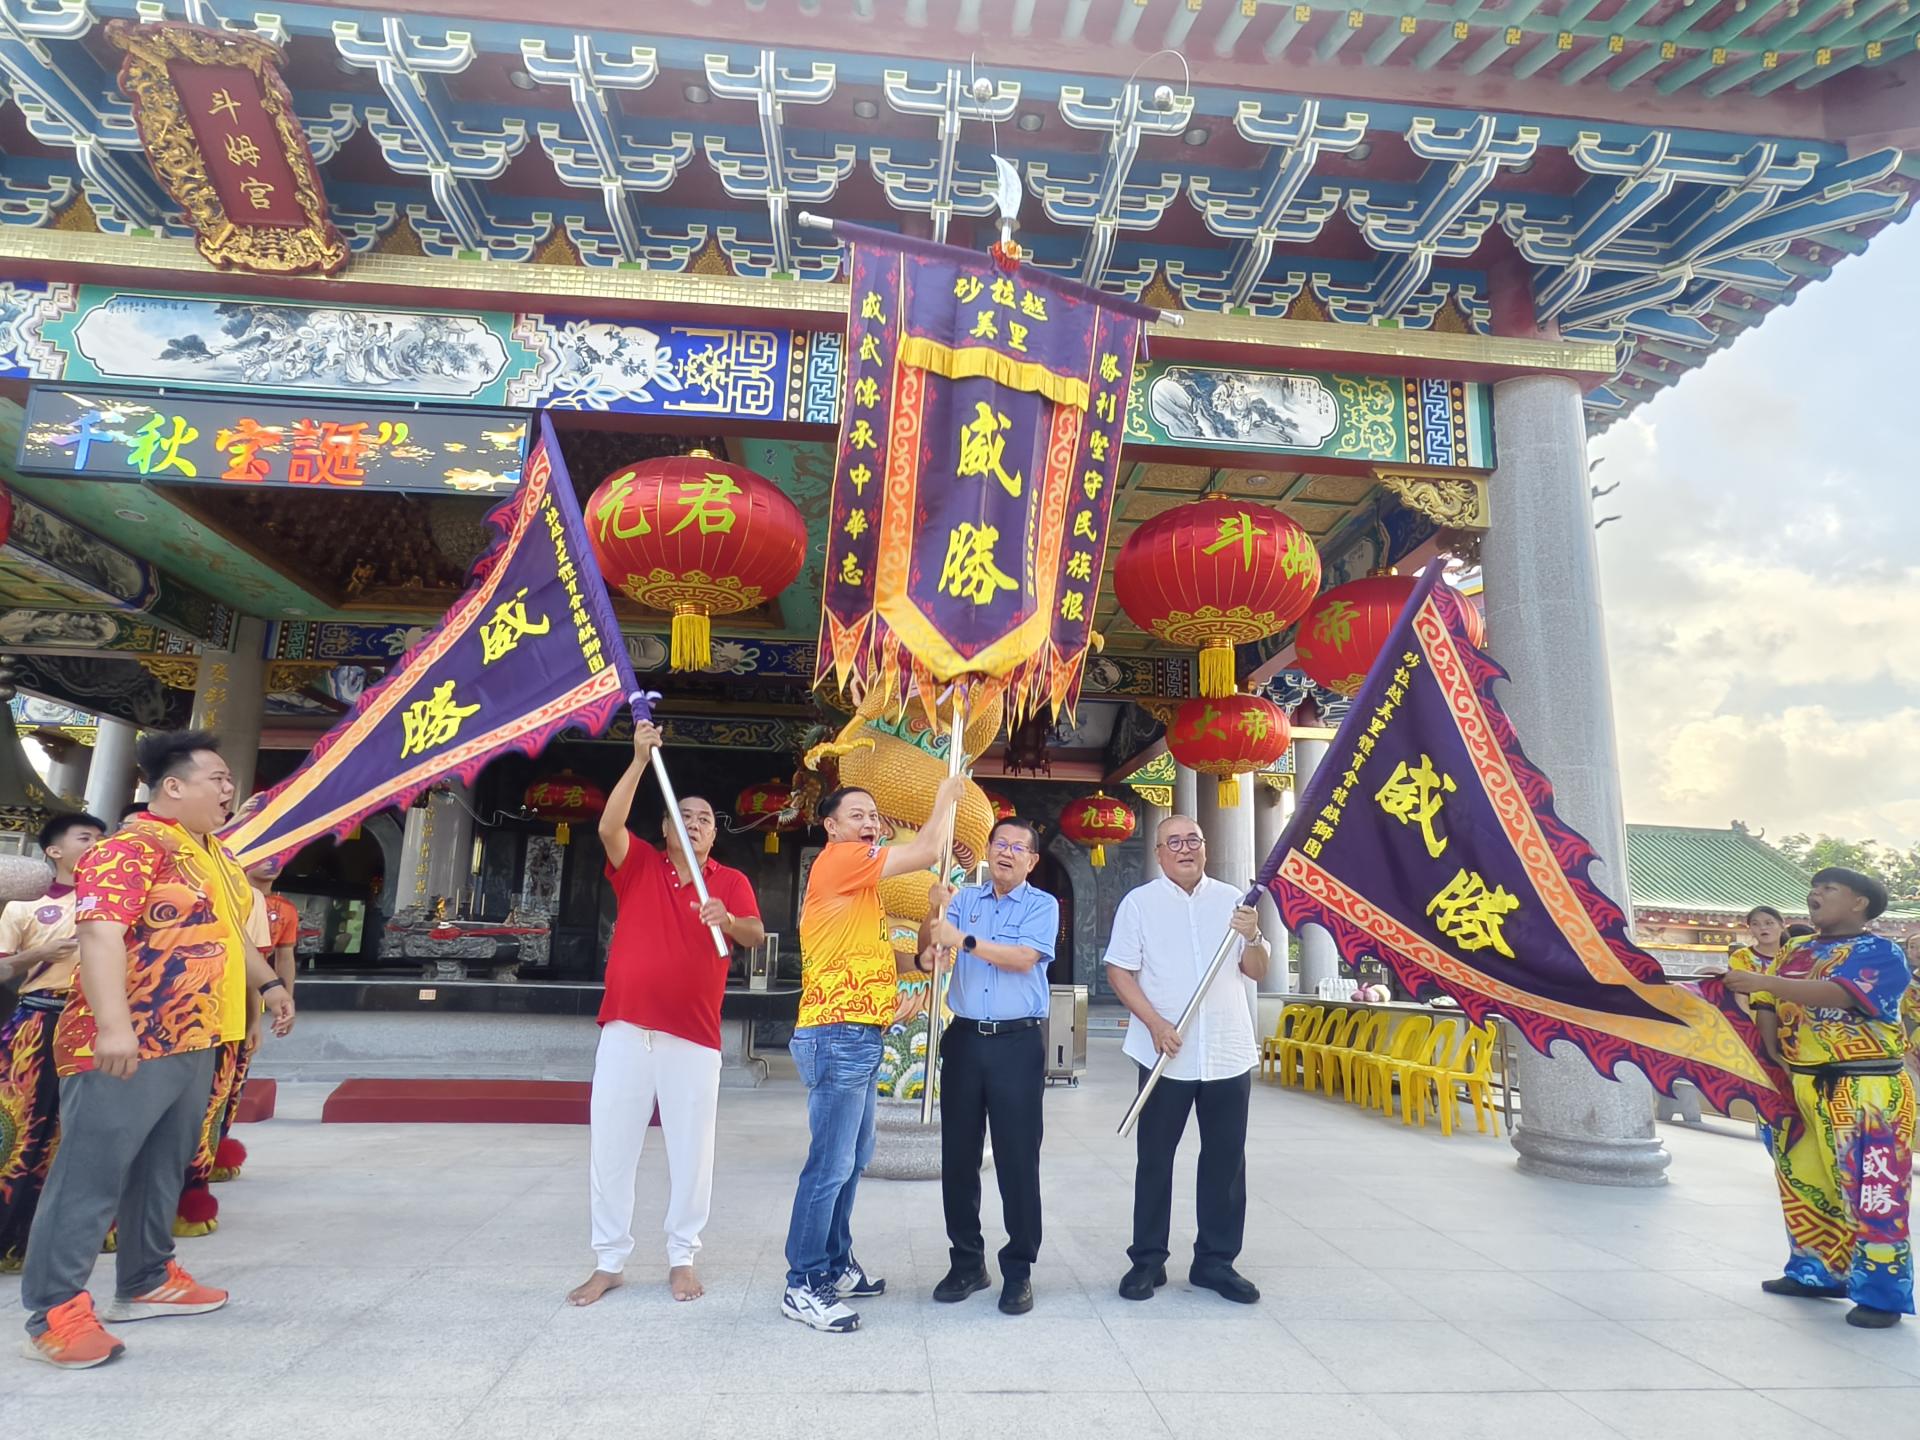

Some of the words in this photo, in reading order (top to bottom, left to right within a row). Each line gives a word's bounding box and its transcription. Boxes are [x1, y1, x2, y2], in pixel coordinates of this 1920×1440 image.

[954, 275, 1048, 321] 砂拉越
[969, 310, 1028, 352] 美里
[839, 291, 886, 586] 威武傳承中華志
[597, 472, 742, 542] 元君
[938, 402, 1022, 605] 威勝
[1060, 352, 1123, 622] 勝利堅守民族根
[400, 587, 551, 759] 威勝
[532, 783, 585, 807] 元君
[1081, 806, 1126, 830] 九皇
[1374, 753, 1520, 958] 威勝
[1859, 1146, 1900, 1214] 威勝
